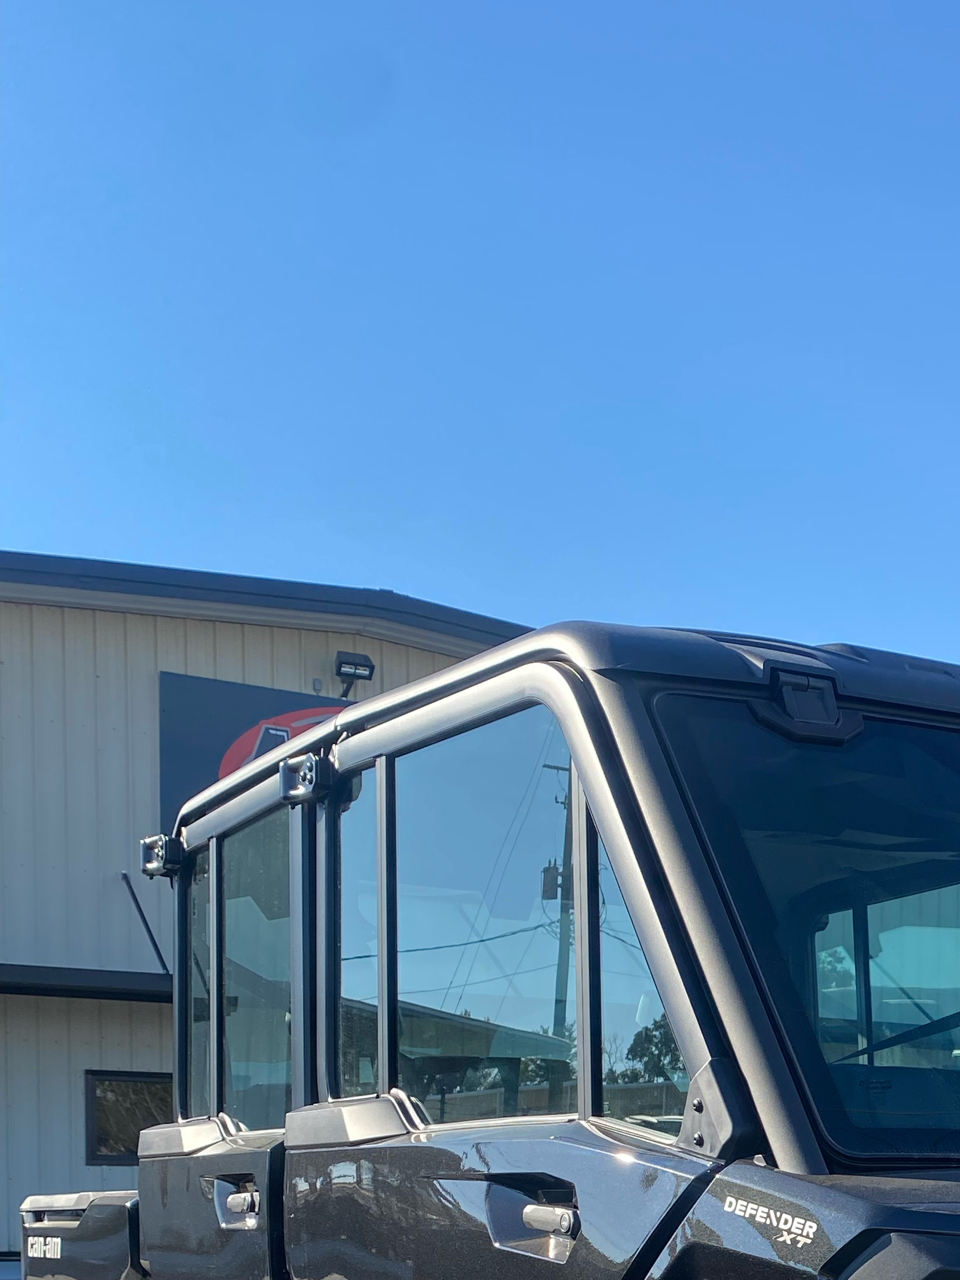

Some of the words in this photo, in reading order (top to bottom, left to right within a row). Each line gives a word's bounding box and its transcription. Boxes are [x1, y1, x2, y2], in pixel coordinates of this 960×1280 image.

[723, 1195, 818, 1238] DEFENDER
[28, 1236, 62, 1259] can-am
[773, 1230, 813, 1248] XT
